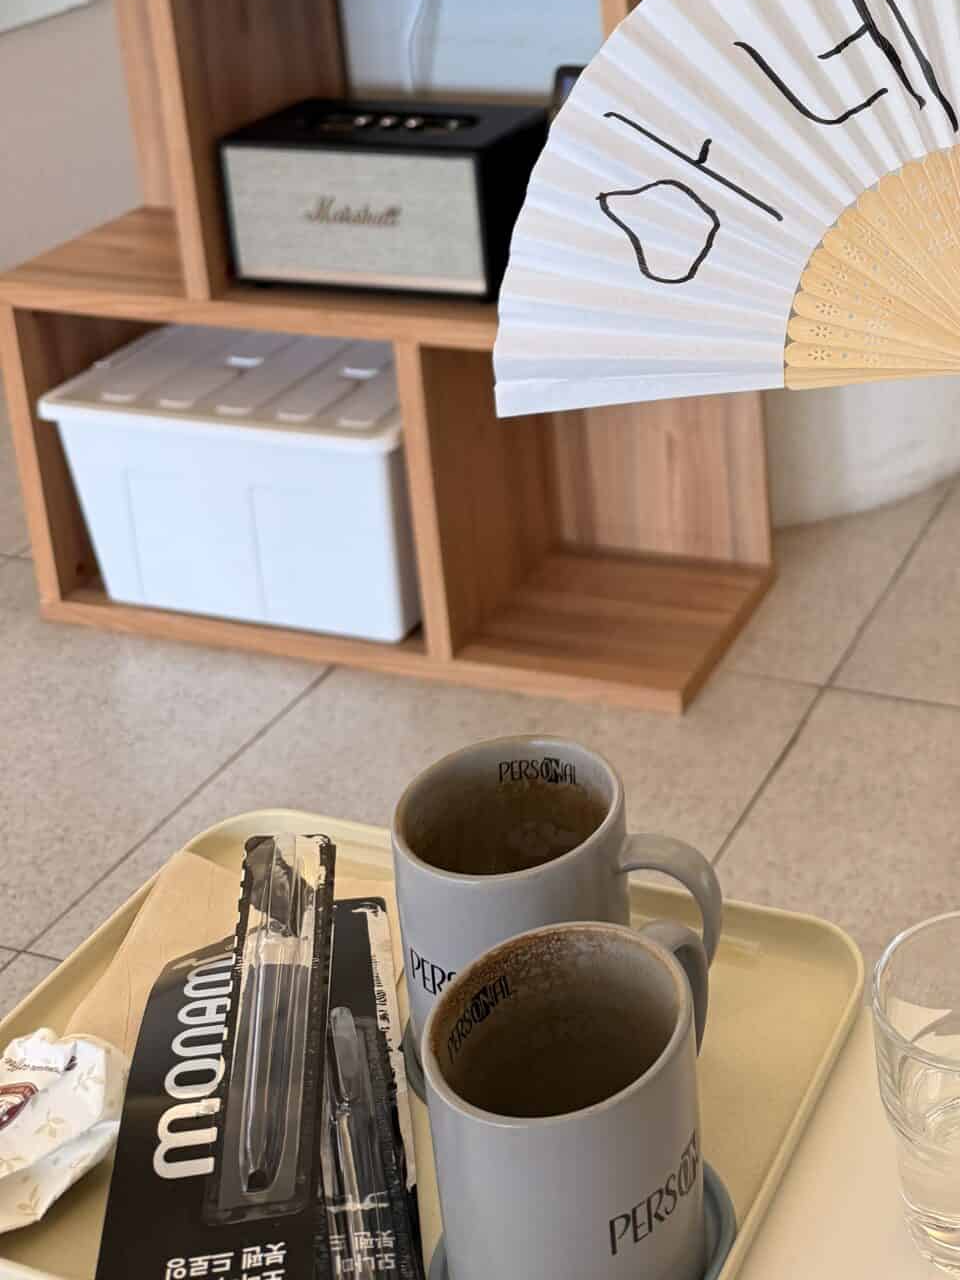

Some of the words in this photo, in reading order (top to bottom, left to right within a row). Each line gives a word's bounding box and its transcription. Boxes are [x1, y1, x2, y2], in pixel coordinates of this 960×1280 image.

[304, 193, 402, 227] Marshall
[165, 1251, 235, 1280] 드로잉
[242, 1241, 287, 1270] 붓펜
